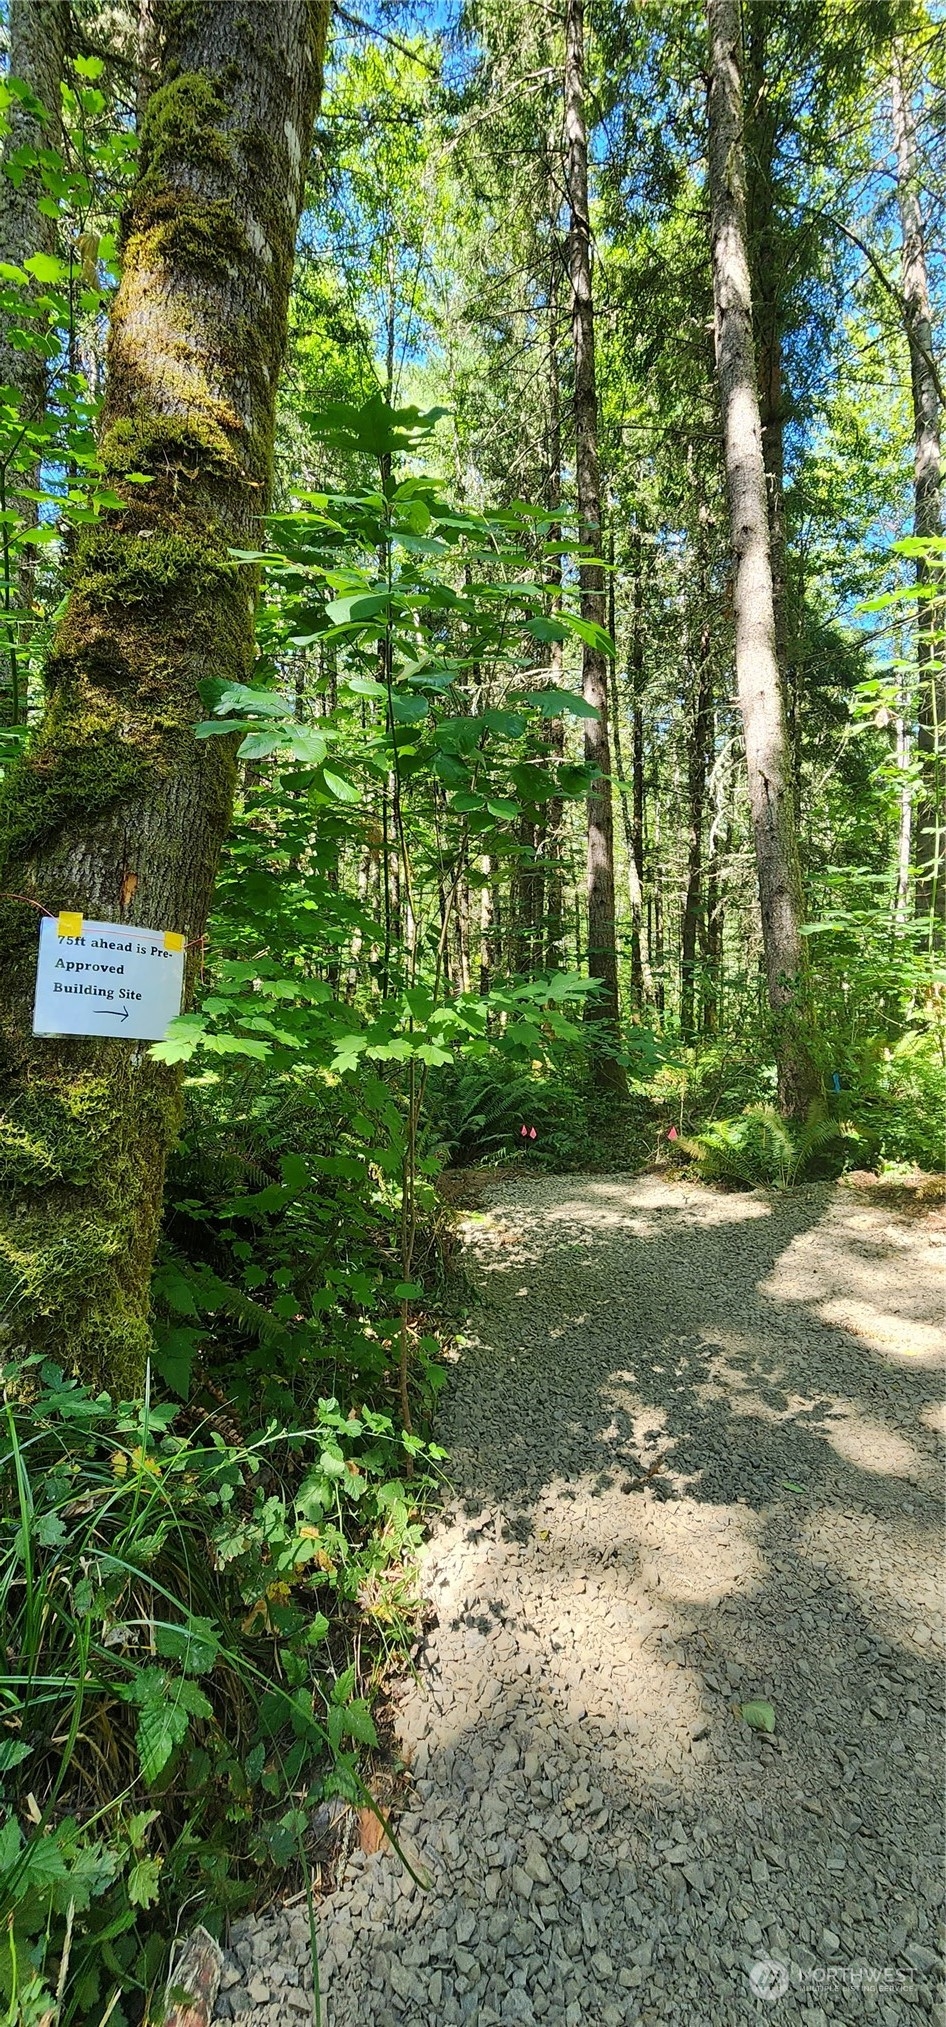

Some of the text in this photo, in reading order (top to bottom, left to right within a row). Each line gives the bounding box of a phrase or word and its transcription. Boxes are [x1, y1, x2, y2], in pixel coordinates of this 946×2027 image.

[58, 936, 173, 958] 75ft ahead is Pre-
[55, 958, 124, 975] Approved
[53, 982, 142, 1001] Building Site
